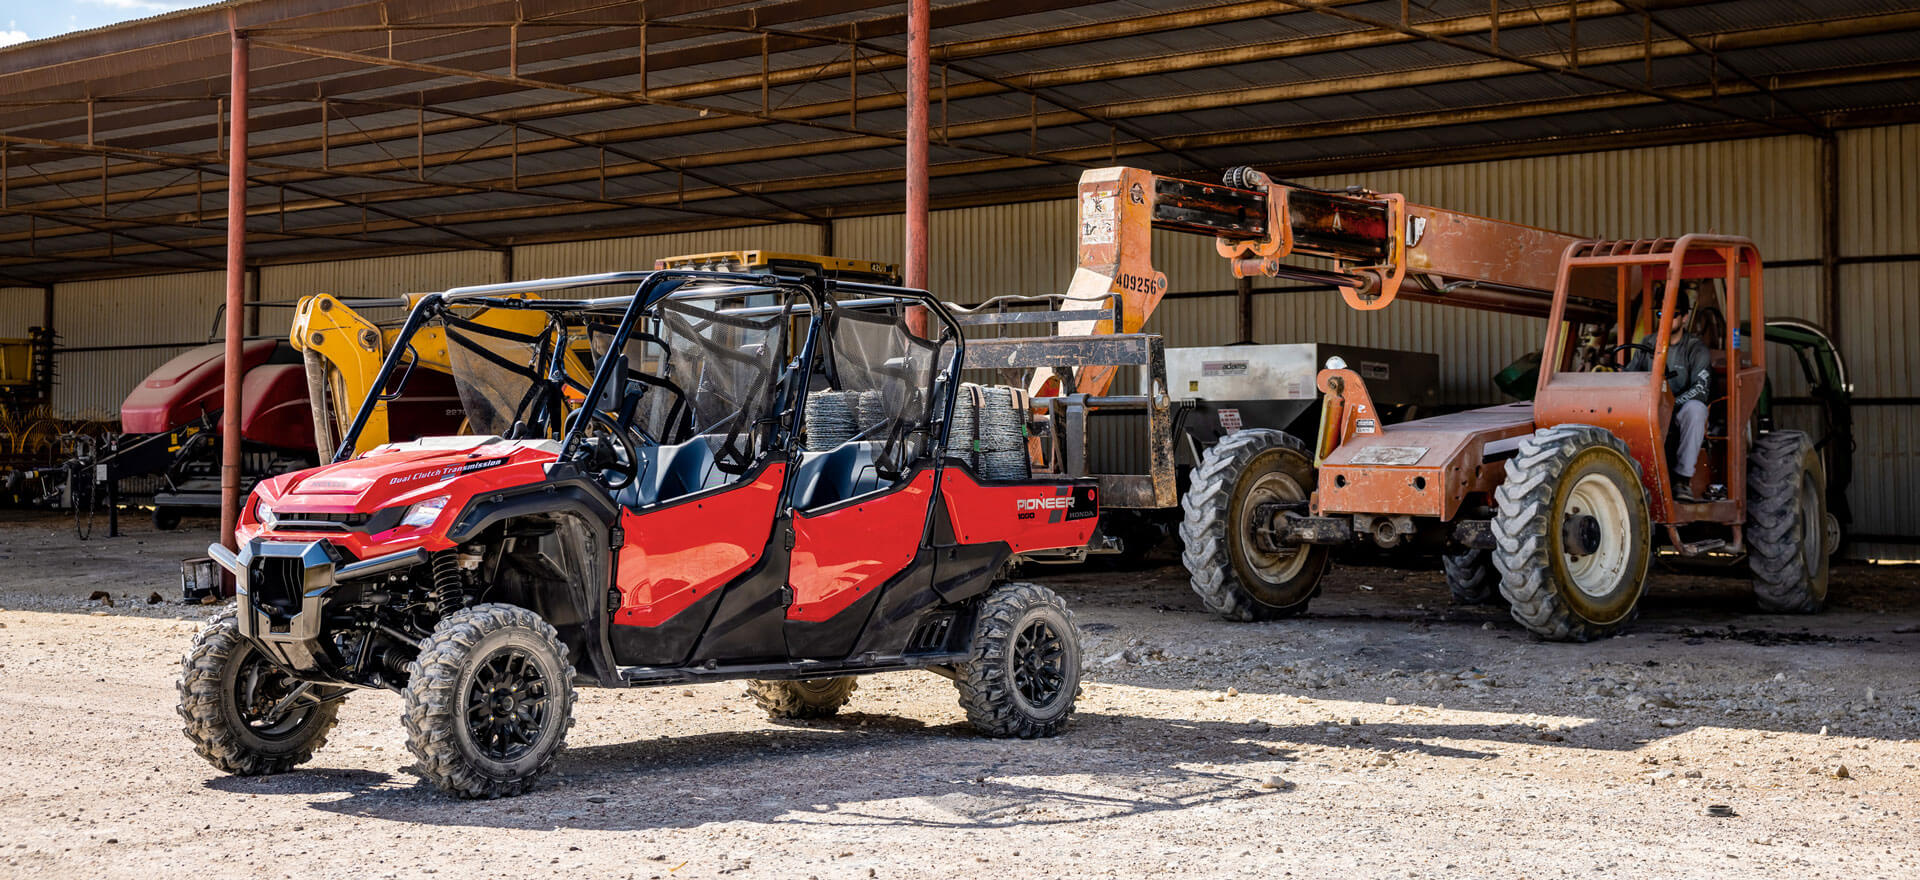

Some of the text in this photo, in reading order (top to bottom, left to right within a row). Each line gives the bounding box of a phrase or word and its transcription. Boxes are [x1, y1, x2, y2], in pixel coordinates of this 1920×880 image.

[1116, 272, 1157, 295] 409256
[389, 459, 501, 485] Dual Clutch Transmission
[1016, 497, 1075, 510] PIONEER
[1018, 512, 1035, 520] 1000
[1069, 511, 1094, 519] HONDA
